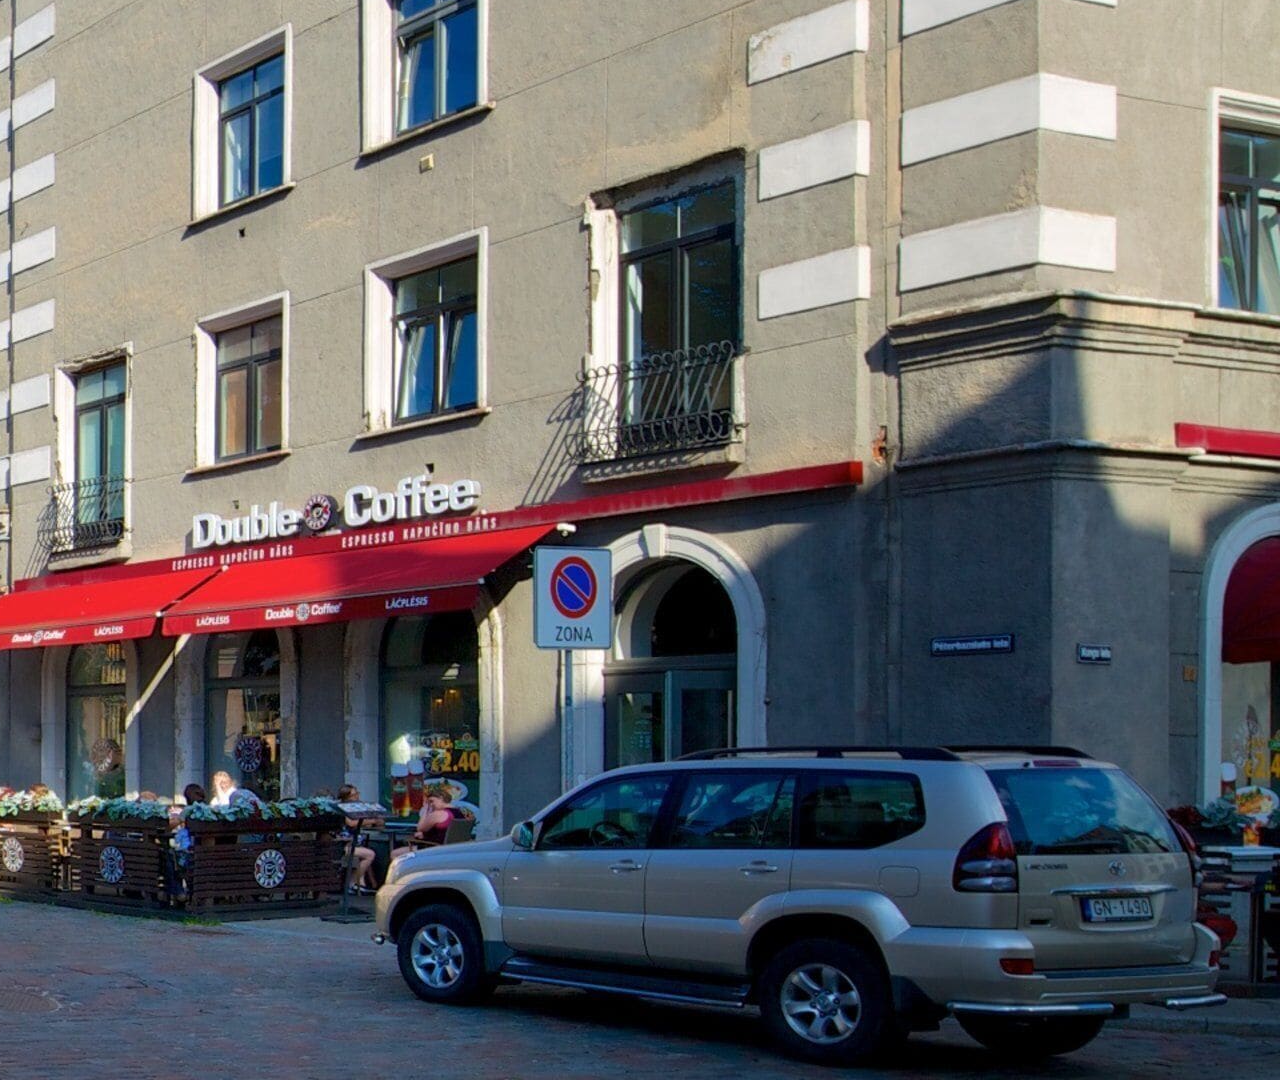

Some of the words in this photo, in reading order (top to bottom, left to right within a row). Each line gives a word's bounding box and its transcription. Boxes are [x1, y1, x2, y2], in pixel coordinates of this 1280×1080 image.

[191, 501, 301, 549] Double
[344, 474, 478, 527] Coffee
[341, 531, 395, 549] ESPRESSO
[403, 522, 460, 540] KAPUČĪNO
[467, 517, 497, 533] BĀRS
[172, 556, 214, 571] ESPRESSO
[265, 609, 294, 621] Double
[311, 603, 341, 616] Coffee
[555, 626, 593, 642] ZONA
[1093, 898, 1150, 917] GN-1490
